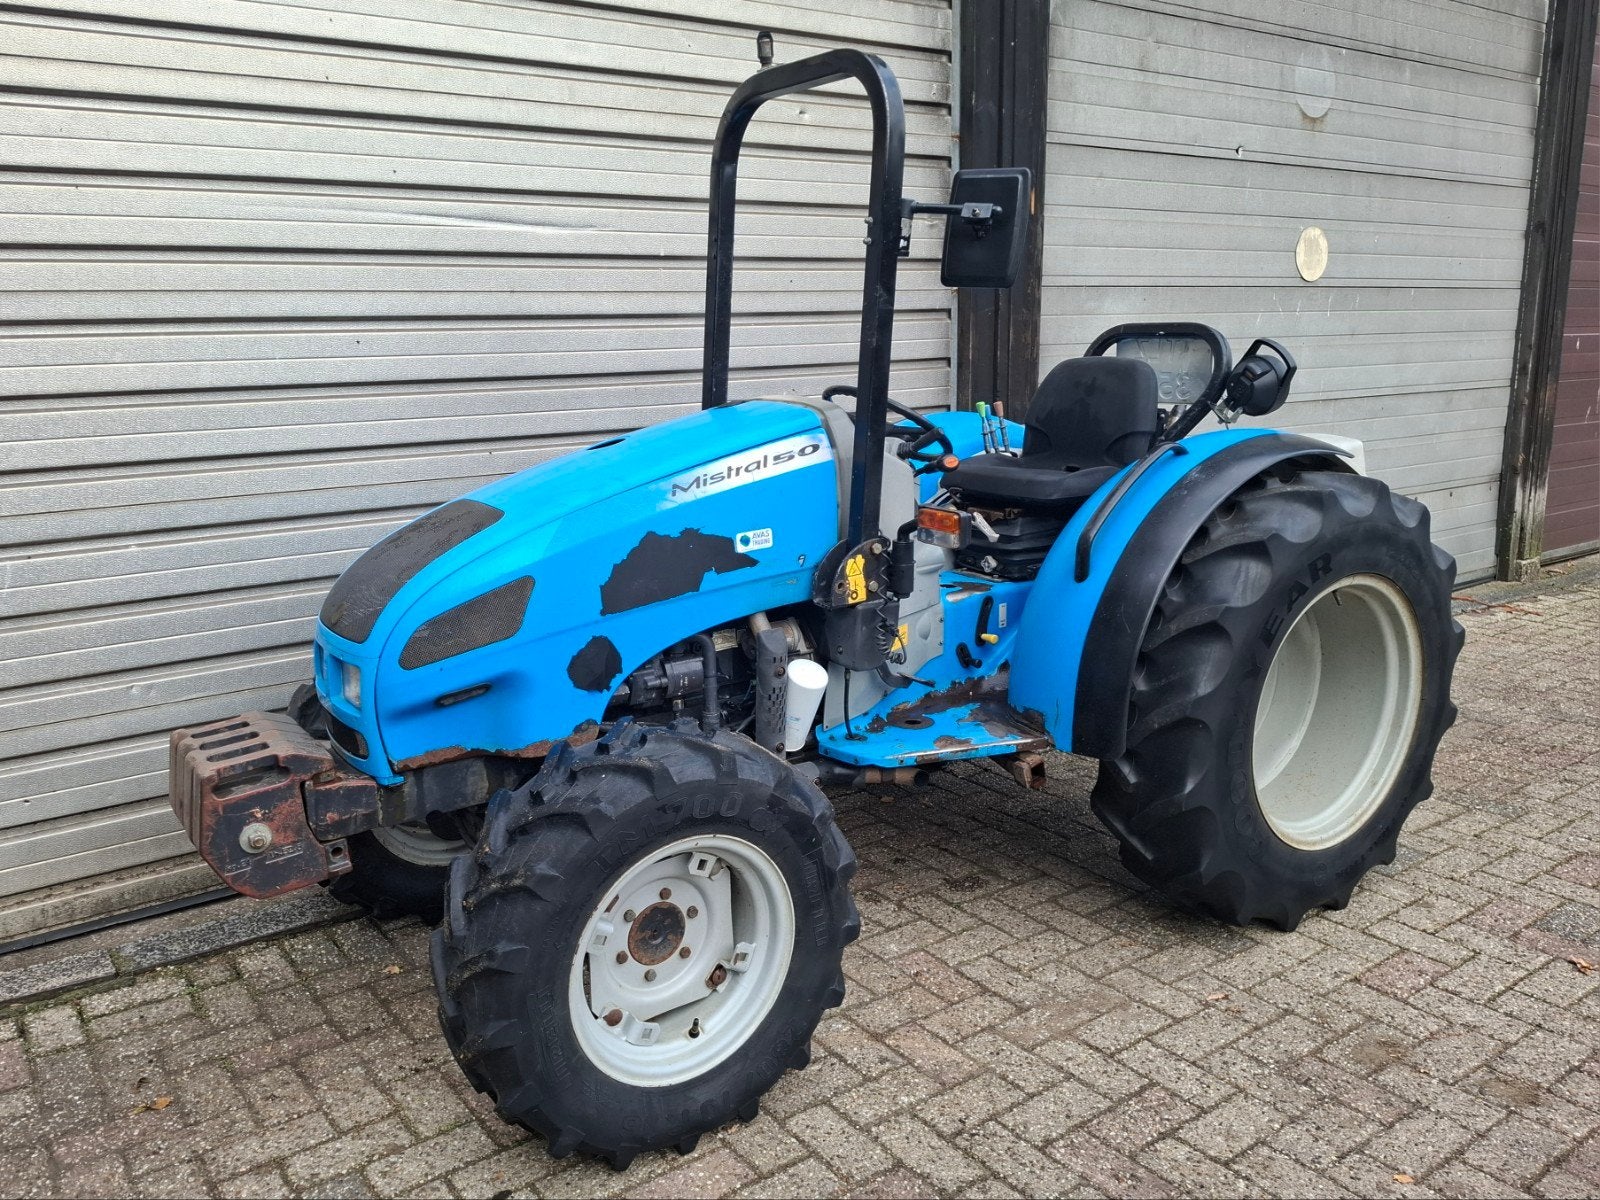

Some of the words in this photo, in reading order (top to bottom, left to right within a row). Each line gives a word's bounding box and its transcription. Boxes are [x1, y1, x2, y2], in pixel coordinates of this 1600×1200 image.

[671, 454, 768, 497] Mistral
[772, 443, 821, 466] 50
[752, 529, 770, 540] AVAS
